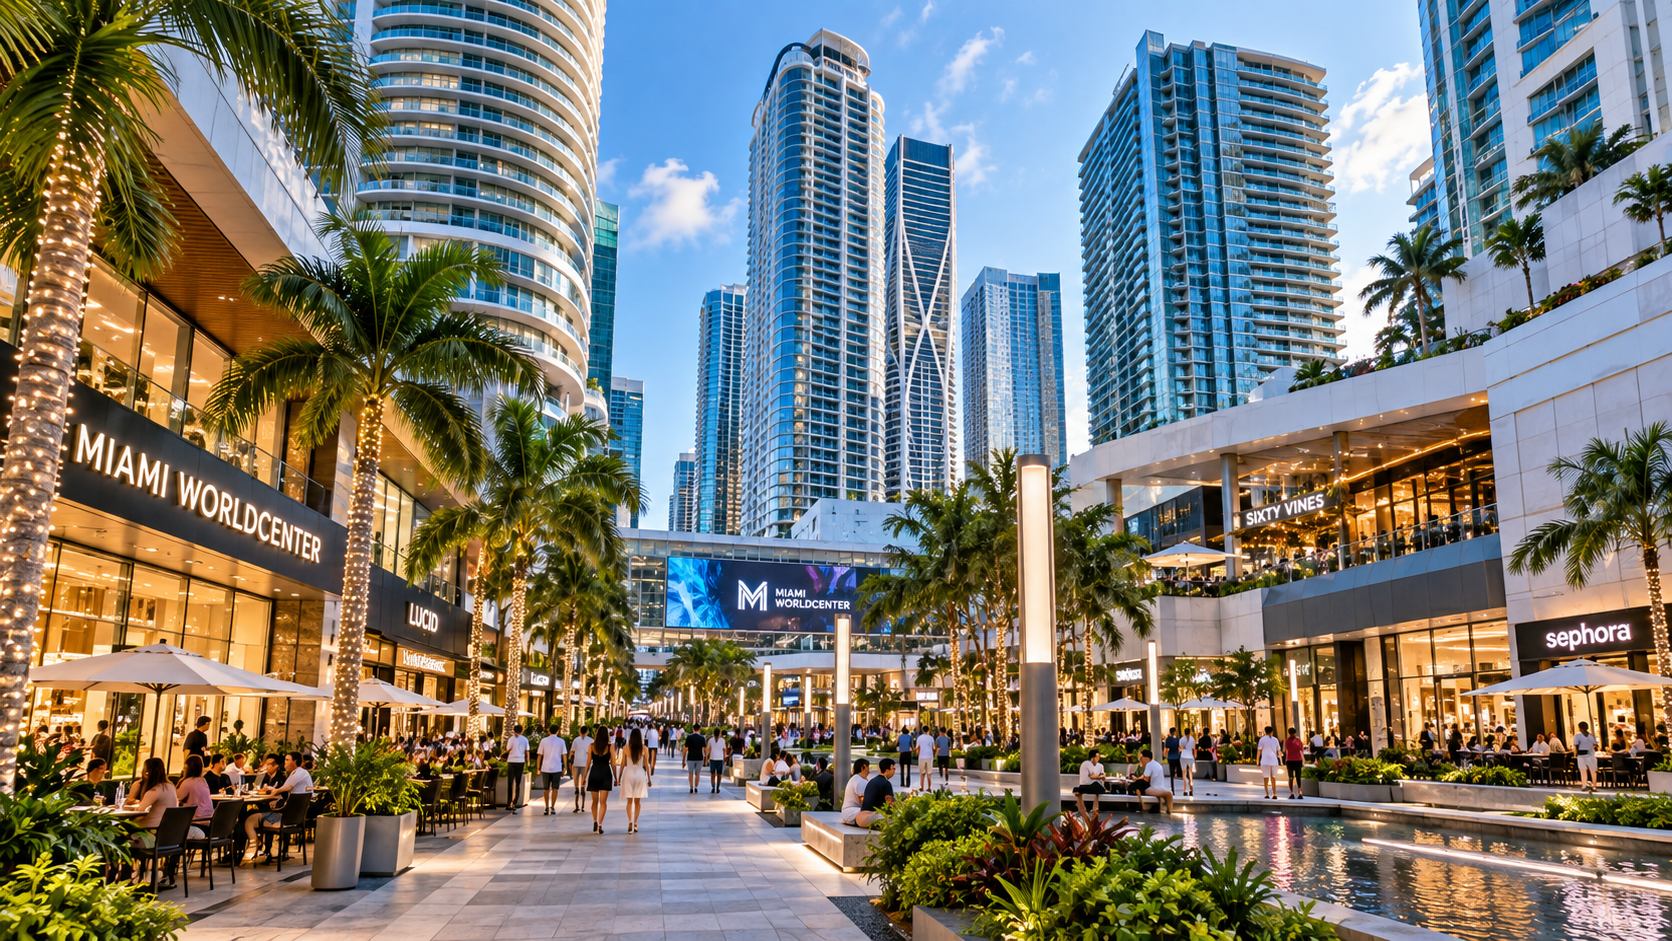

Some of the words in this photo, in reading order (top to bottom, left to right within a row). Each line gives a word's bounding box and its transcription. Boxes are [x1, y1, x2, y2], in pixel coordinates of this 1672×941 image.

[75, 423, 170, 498] MIAMI
[178, 471, 322, 564] WORLDCENTER
[1246, 505, 1281, 526] SIXTY
[1284, 493, 1325, 516] VINES
[775, 588, 806, 598] MIAMI
[775, 599, 851, 610] WORLDCENTER
[409, 602, 439, 633] LUCID
[1545, 622, 1632, 651] sephora
